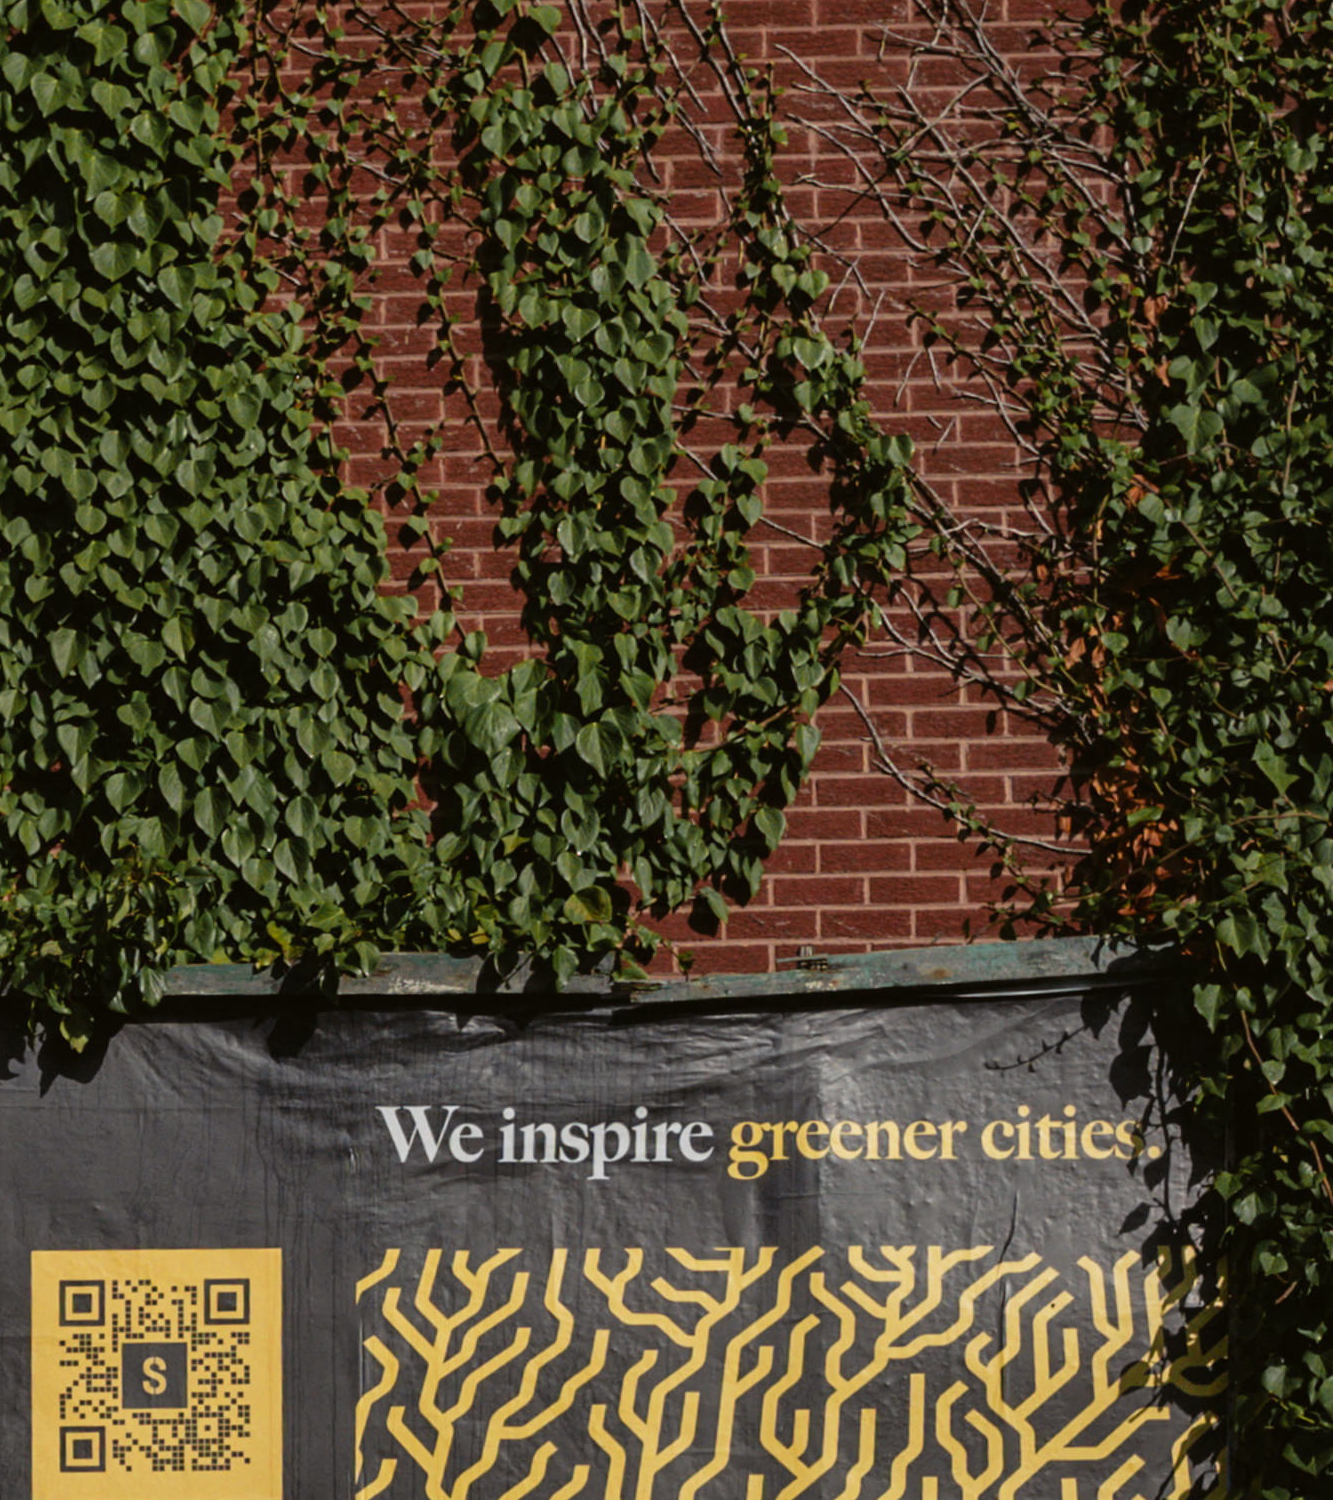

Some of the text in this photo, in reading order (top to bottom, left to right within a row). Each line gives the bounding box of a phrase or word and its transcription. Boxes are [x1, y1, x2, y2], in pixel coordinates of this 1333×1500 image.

[375, 1103, 1162, 1181] We inspire greener cities.
[142, 1356, 166, 1395] S
